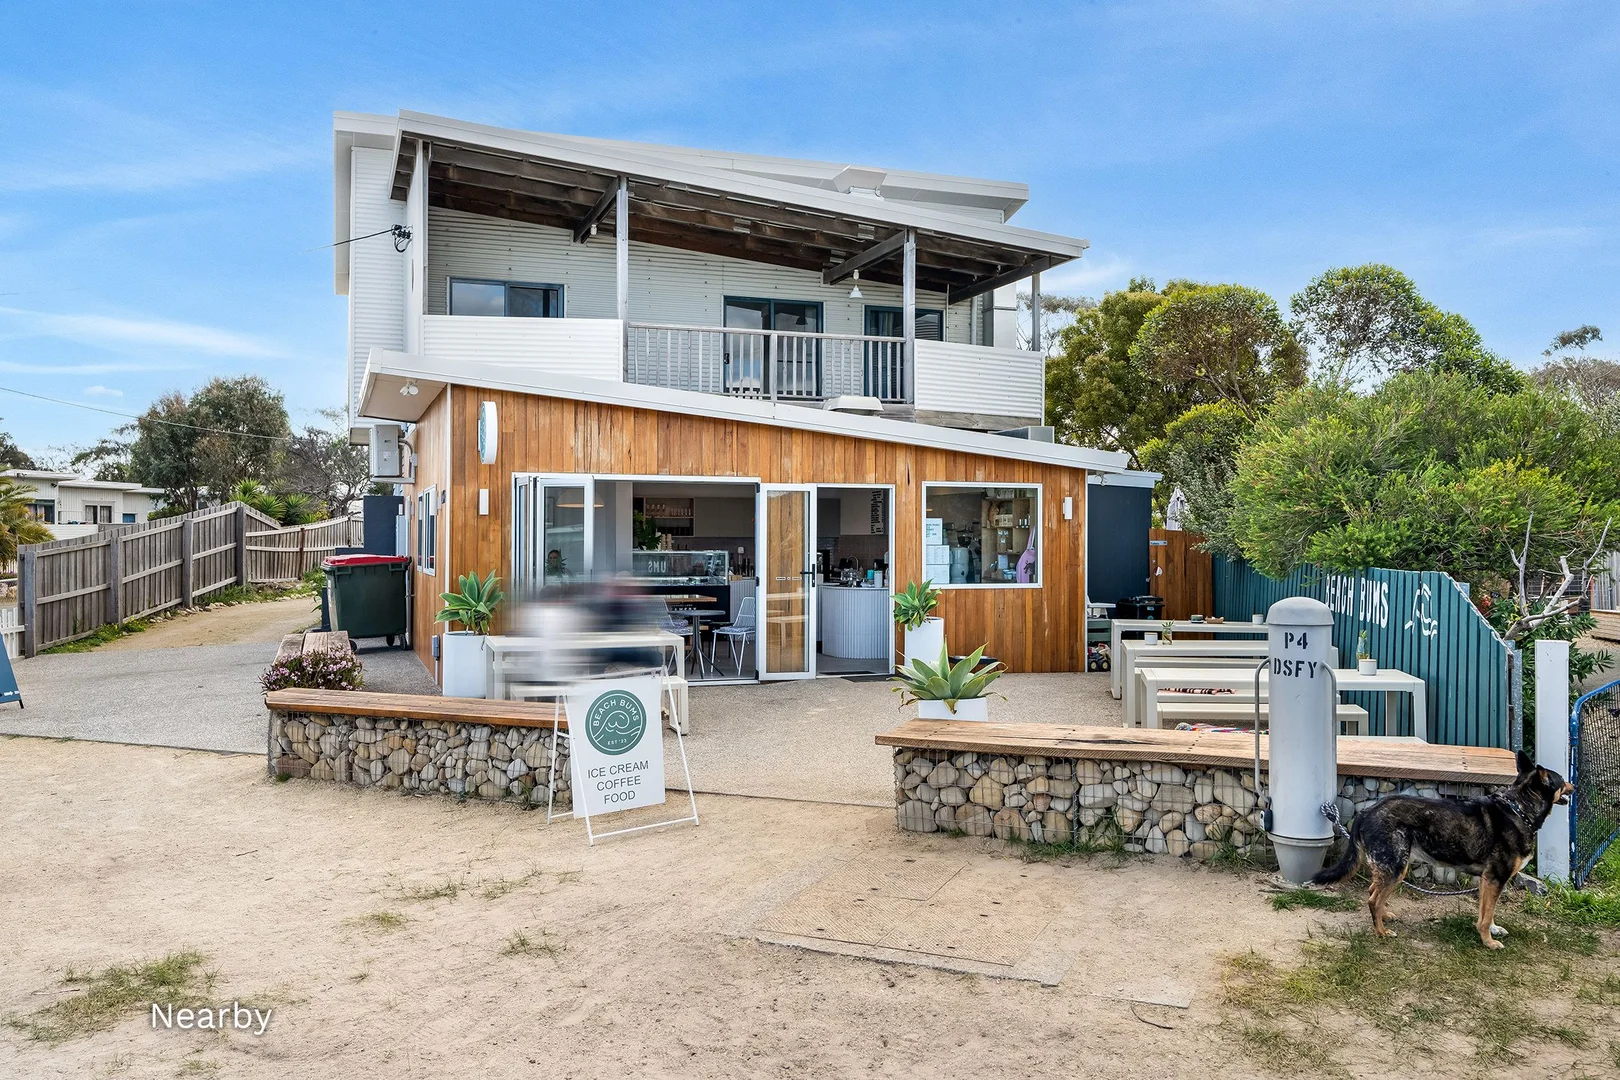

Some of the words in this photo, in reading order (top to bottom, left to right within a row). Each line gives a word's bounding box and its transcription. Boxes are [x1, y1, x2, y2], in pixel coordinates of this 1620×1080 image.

[1325, 574, 1355, 617] BEACH
[1360, 577, 1389, 629] BUMS
[1284, 632, 1308, 650] P4
[1273, 658, 1318, 679] DSFY
[592, 699, 617, 727] BEACH
[619, 699, 640, 722] BUMS
[587, 767, 606, 779] ICE
[609, 760, 649, 775] CREAM
[596, 775, 641, 792] COFFEE
[604, 790, 636, 804] FOOD
